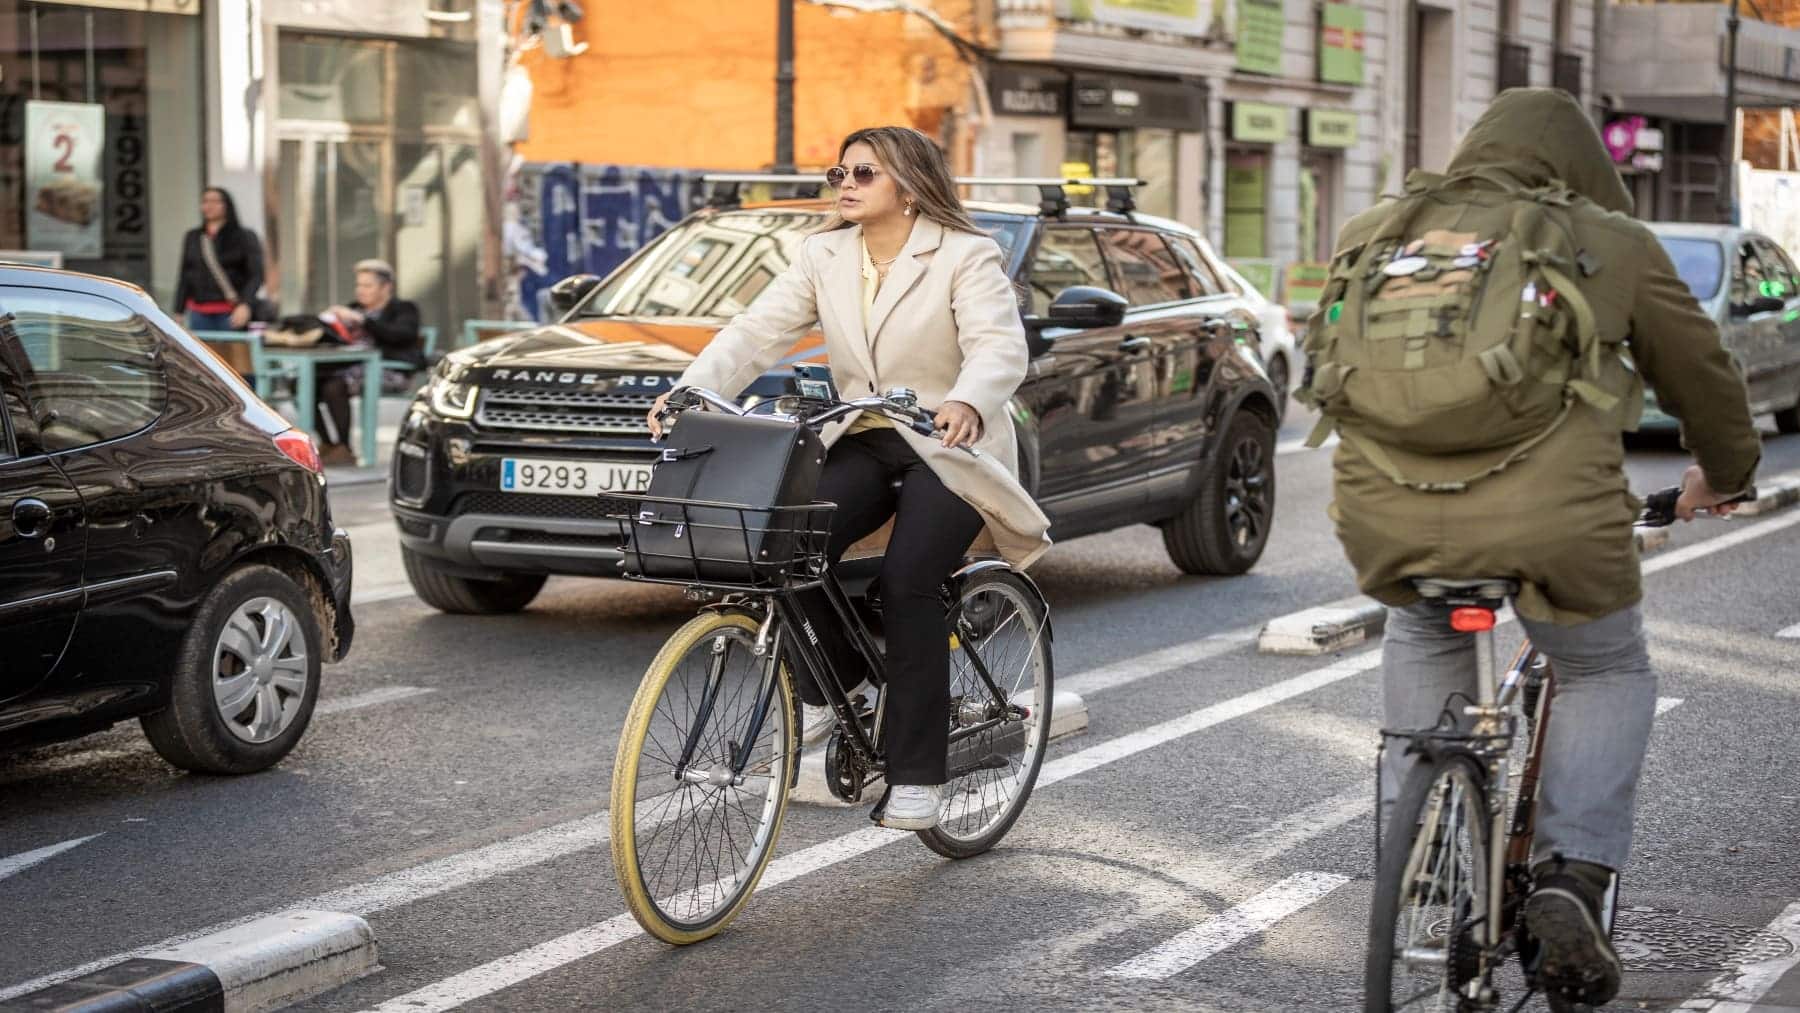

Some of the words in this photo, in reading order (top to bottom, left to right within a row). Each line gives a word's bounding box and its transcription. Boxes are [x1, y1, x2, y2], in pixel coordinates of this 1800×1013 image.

[53, 134, 74, 173] 2
[492, 369, 599, 385] RANGE
[615, 375, 681, 387] ROV
[520, 464, 588, 489] 9293
[599, 469, 650, 491] JVR
